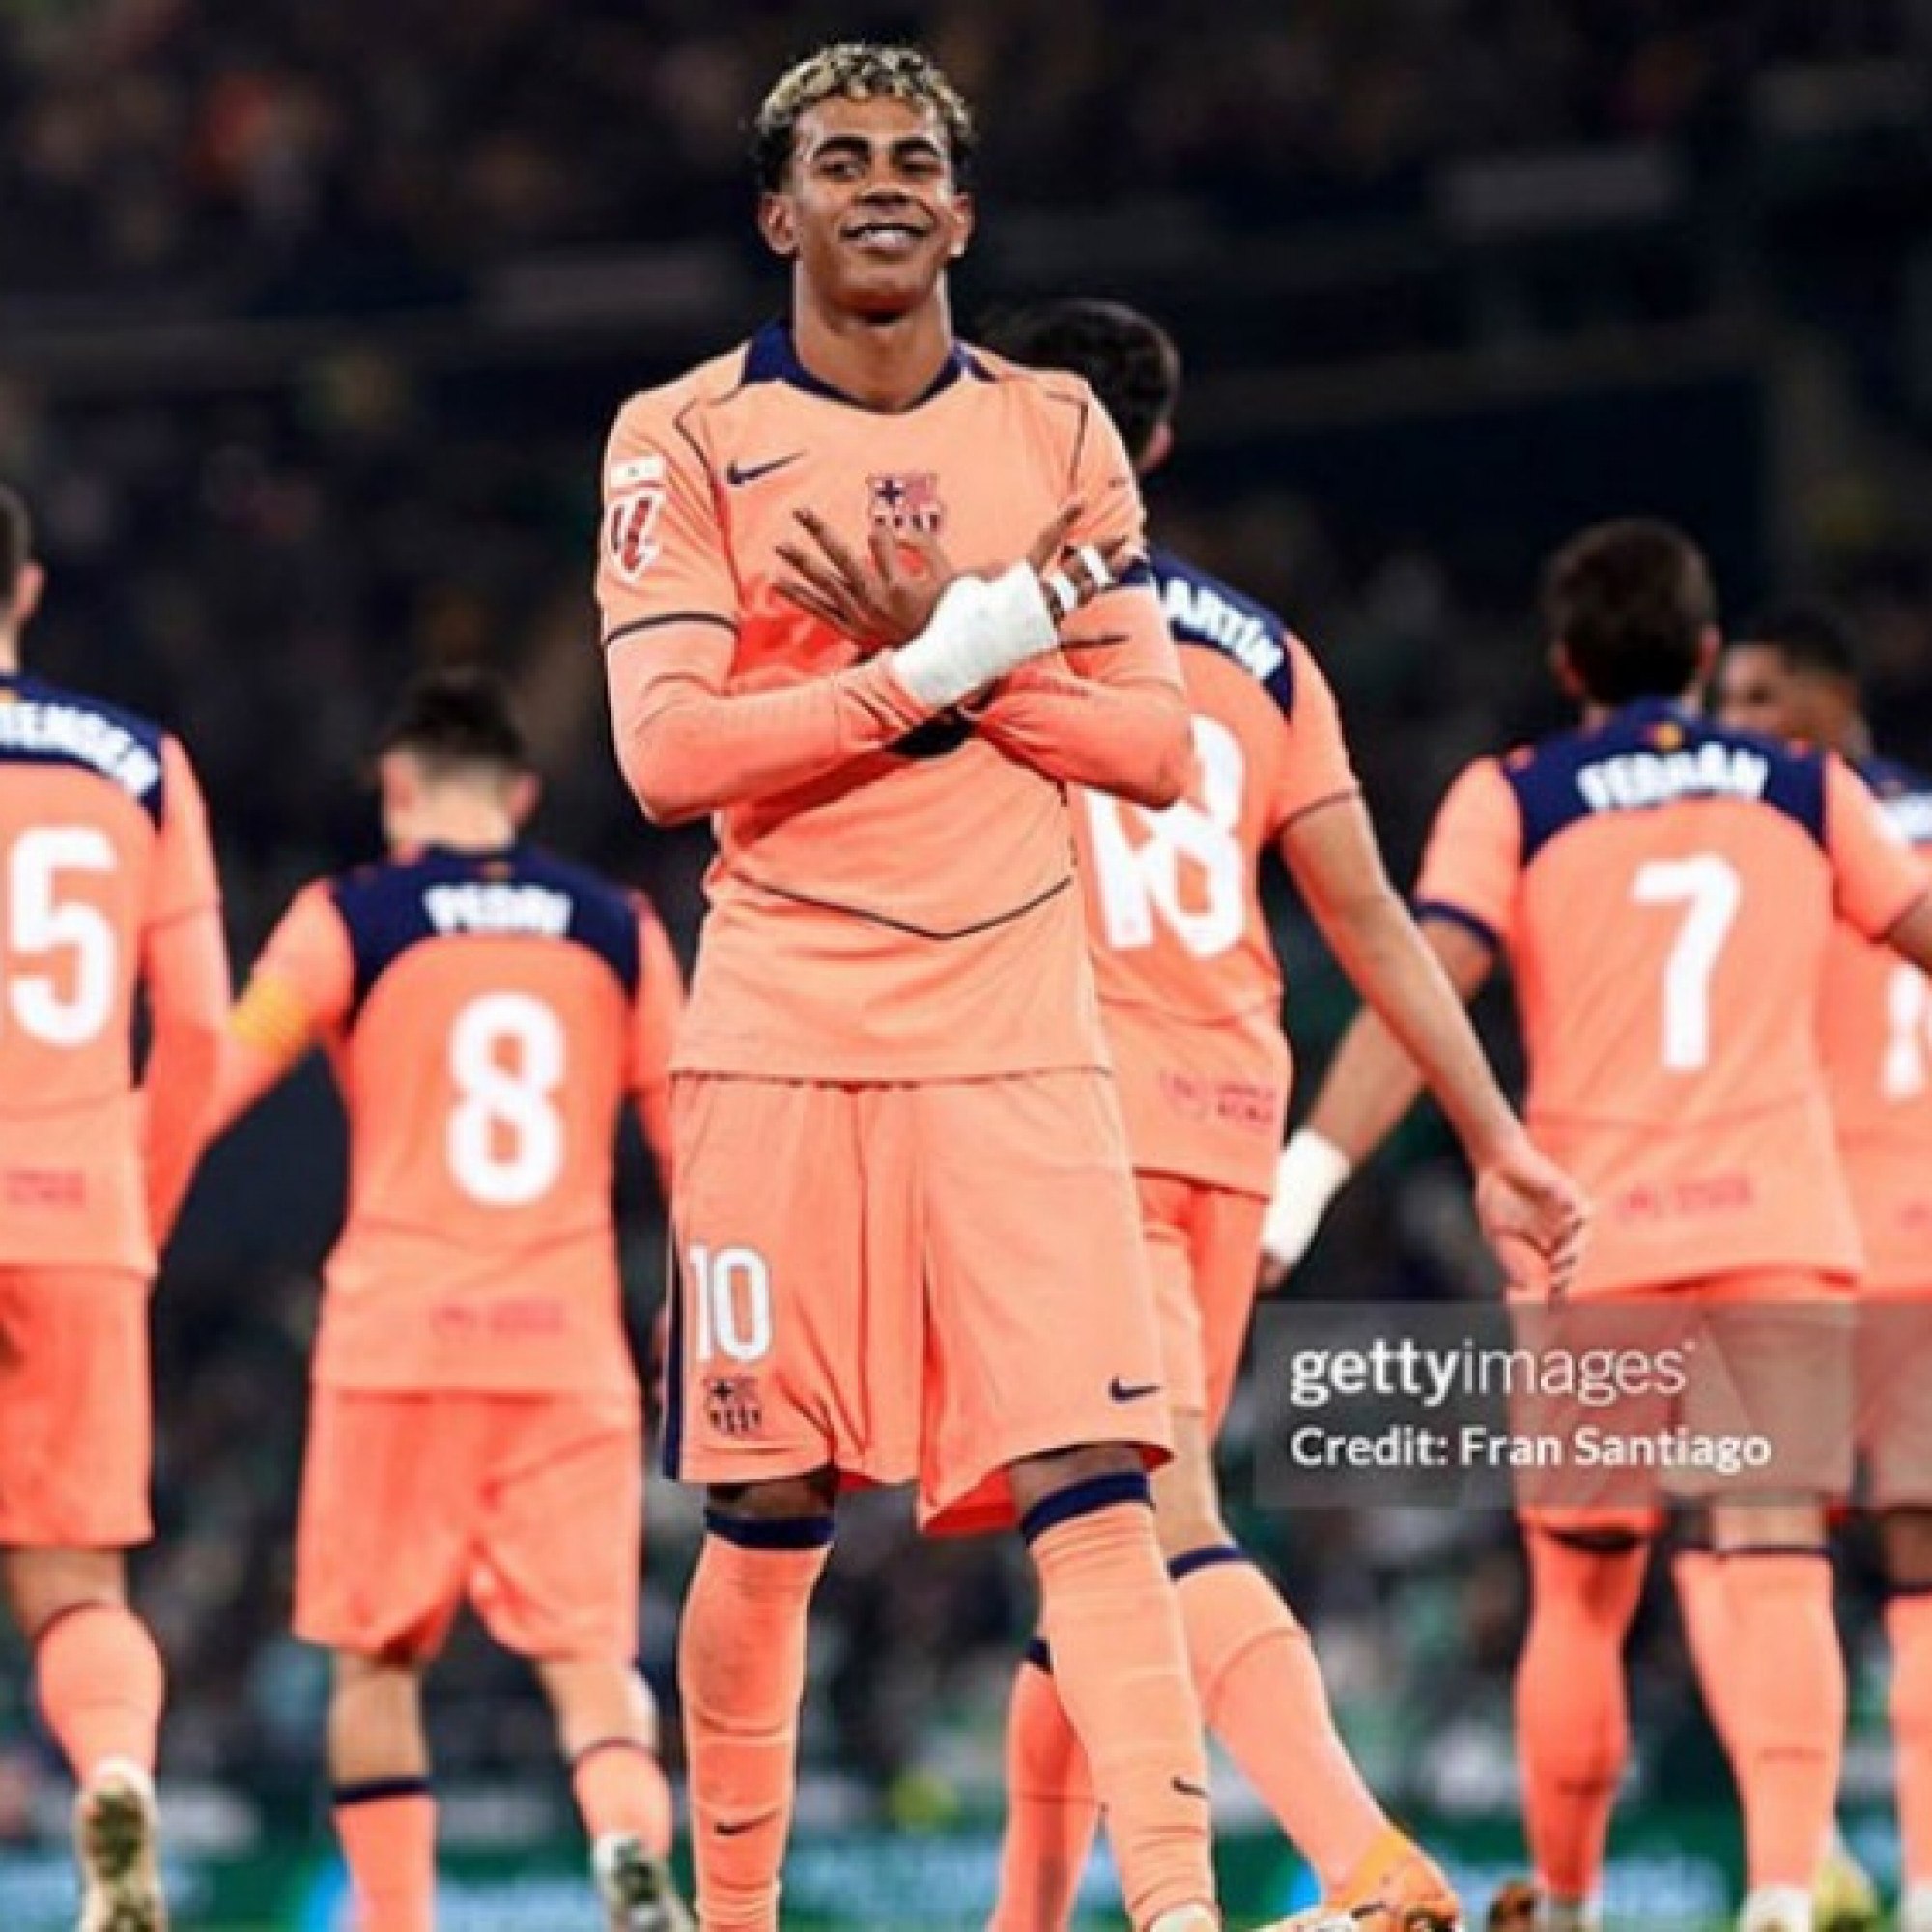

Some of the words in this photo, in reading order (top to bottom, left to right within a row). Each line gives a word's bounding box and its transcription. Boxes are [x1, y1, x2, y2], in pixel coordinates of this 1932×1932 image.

[1631, 851, 1742, 1072] 7
[447, 990, 568, 1206] 8
[689, 1244, 770, 1362] 10
